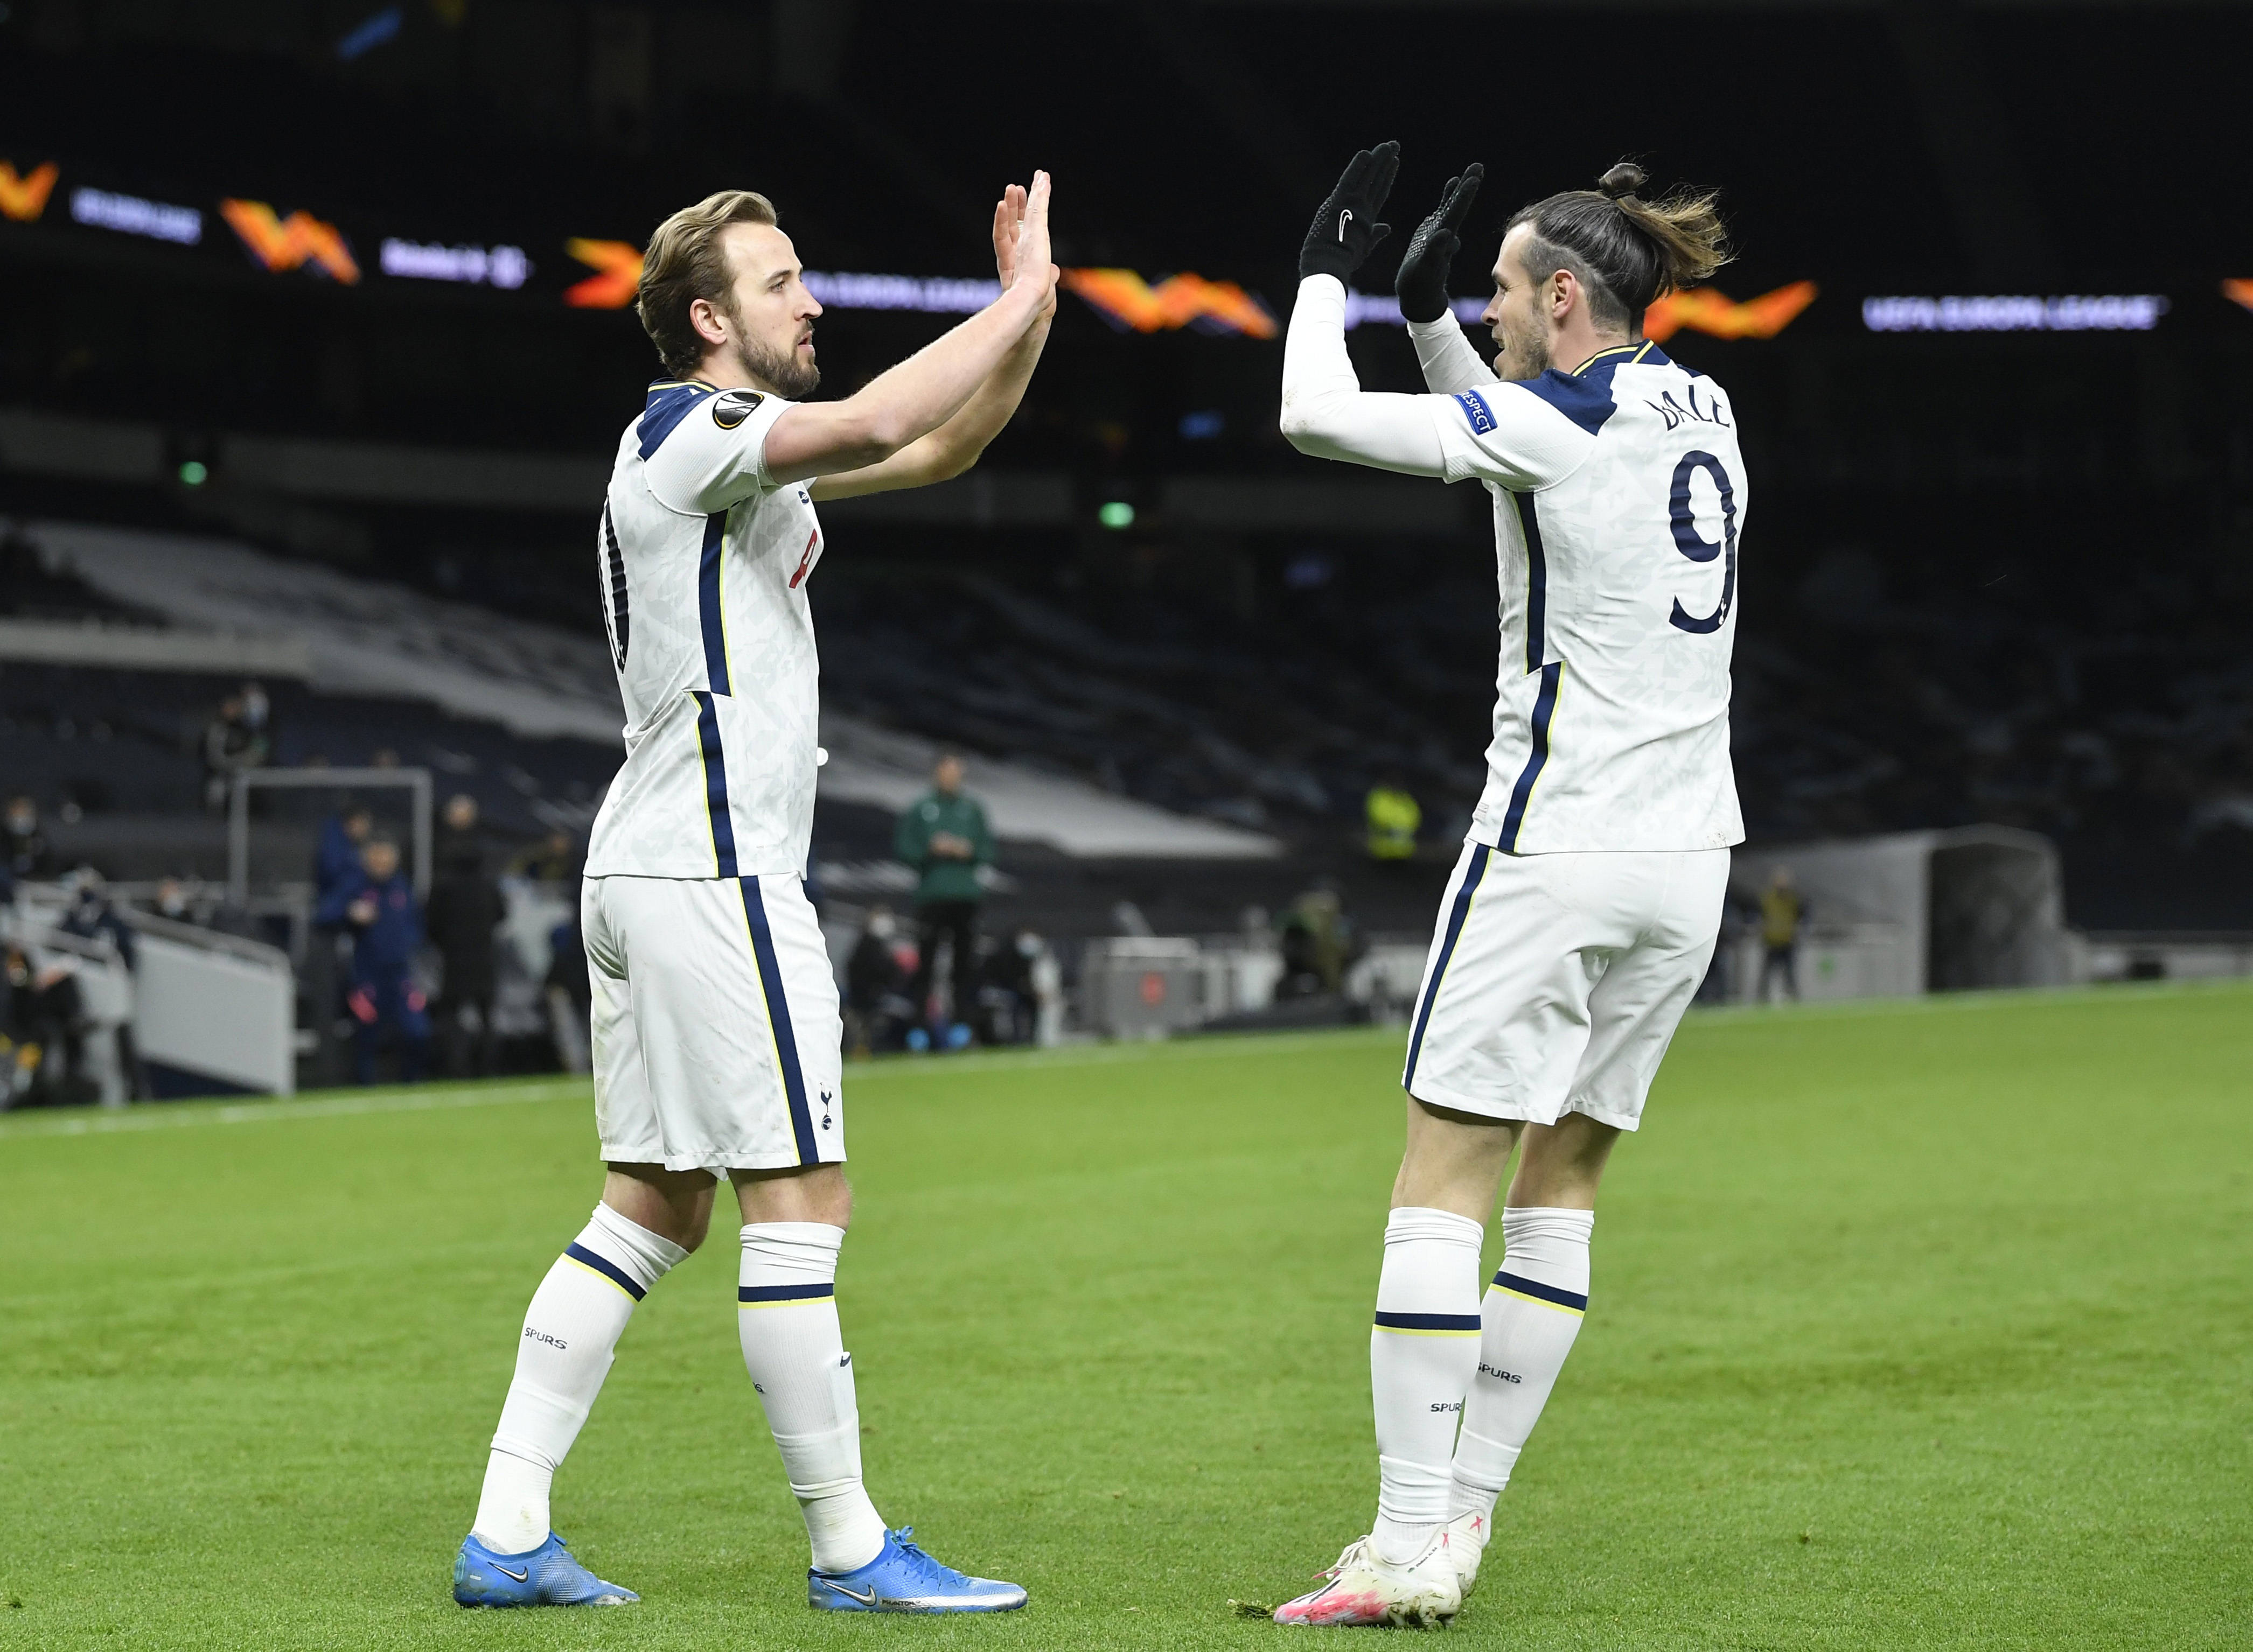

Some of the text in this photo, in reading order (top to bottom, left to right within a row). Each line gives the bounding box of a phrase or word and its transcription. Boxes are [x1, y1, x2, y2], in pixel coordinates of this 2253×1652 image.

[1460, 391, 1491, 430] RESPECT
[1669, 450, 1737, 634] 9
[525, 1327, 568, 1349] SPURS
[1431, 1403, 1462, 1412] SPUR
